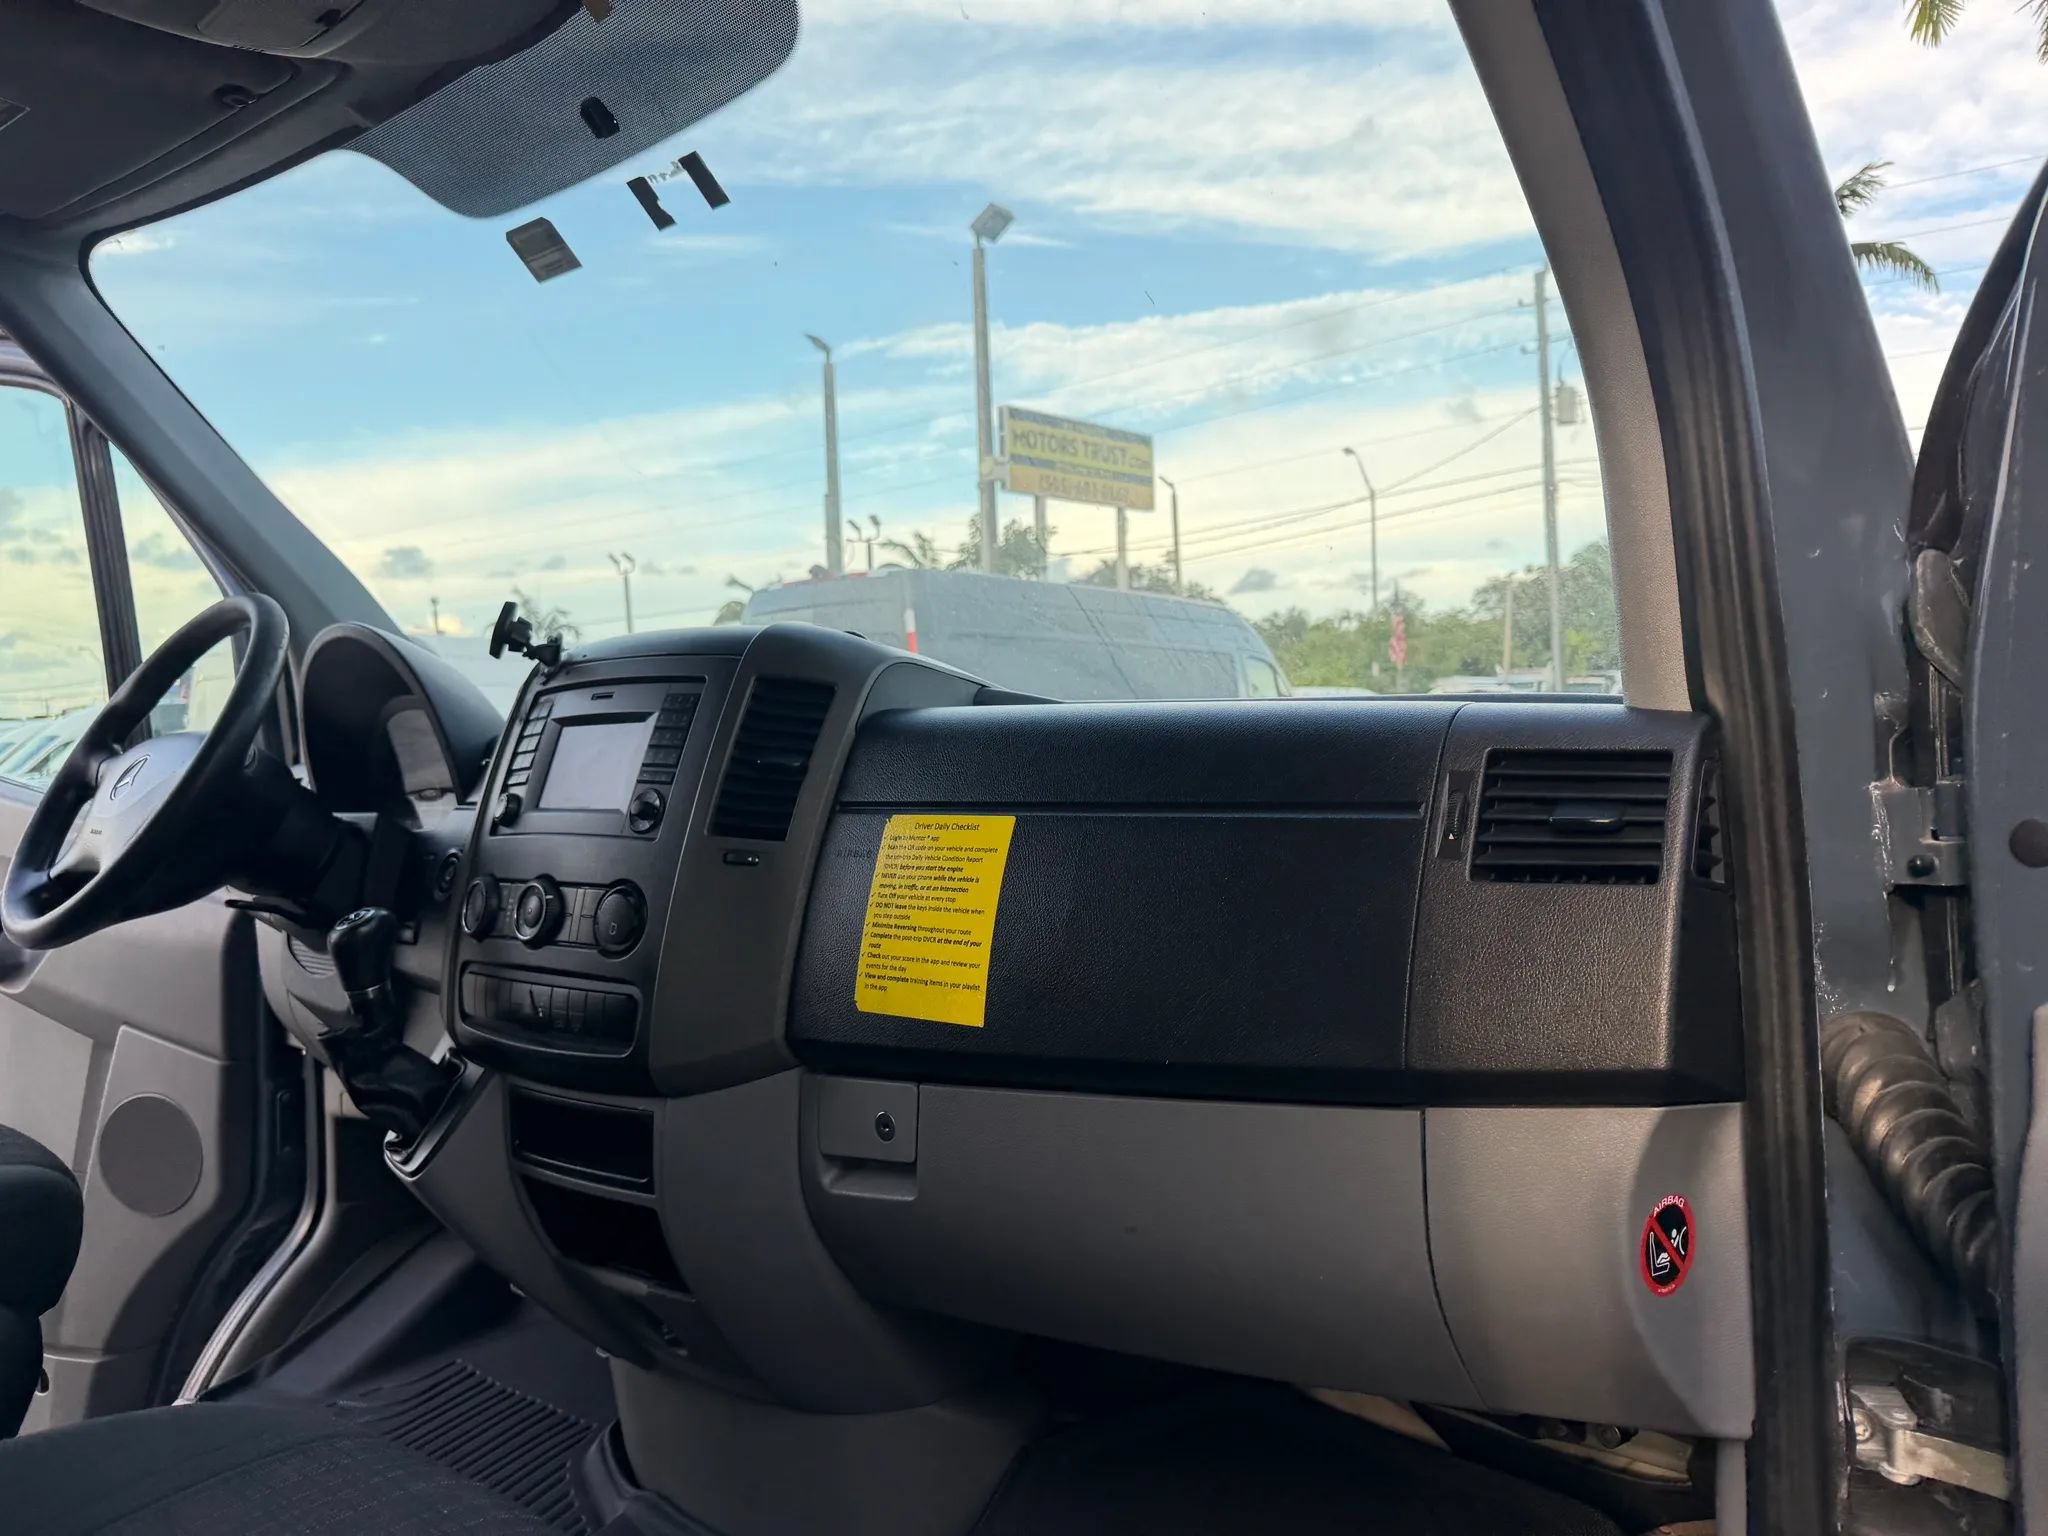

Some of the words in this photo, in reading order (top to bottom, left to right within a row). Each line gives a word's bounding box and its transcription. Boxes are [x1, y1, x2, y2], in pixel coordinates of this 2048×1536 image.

[1013, 431, 1078, 454] MOTORS
[1081, 440, 1127, 465] TRUST
[894, 923, 916, 932] Reversing
[918, 925, 945, 933] throughout
[902, 934, 922, 942] post-trip
[887, 975, 909, 983] complete
[910, 977, 928, 986] training
[962, 983, 980, 991] playlist
[1653, 1195, 1684, 1216] AIRBAG
